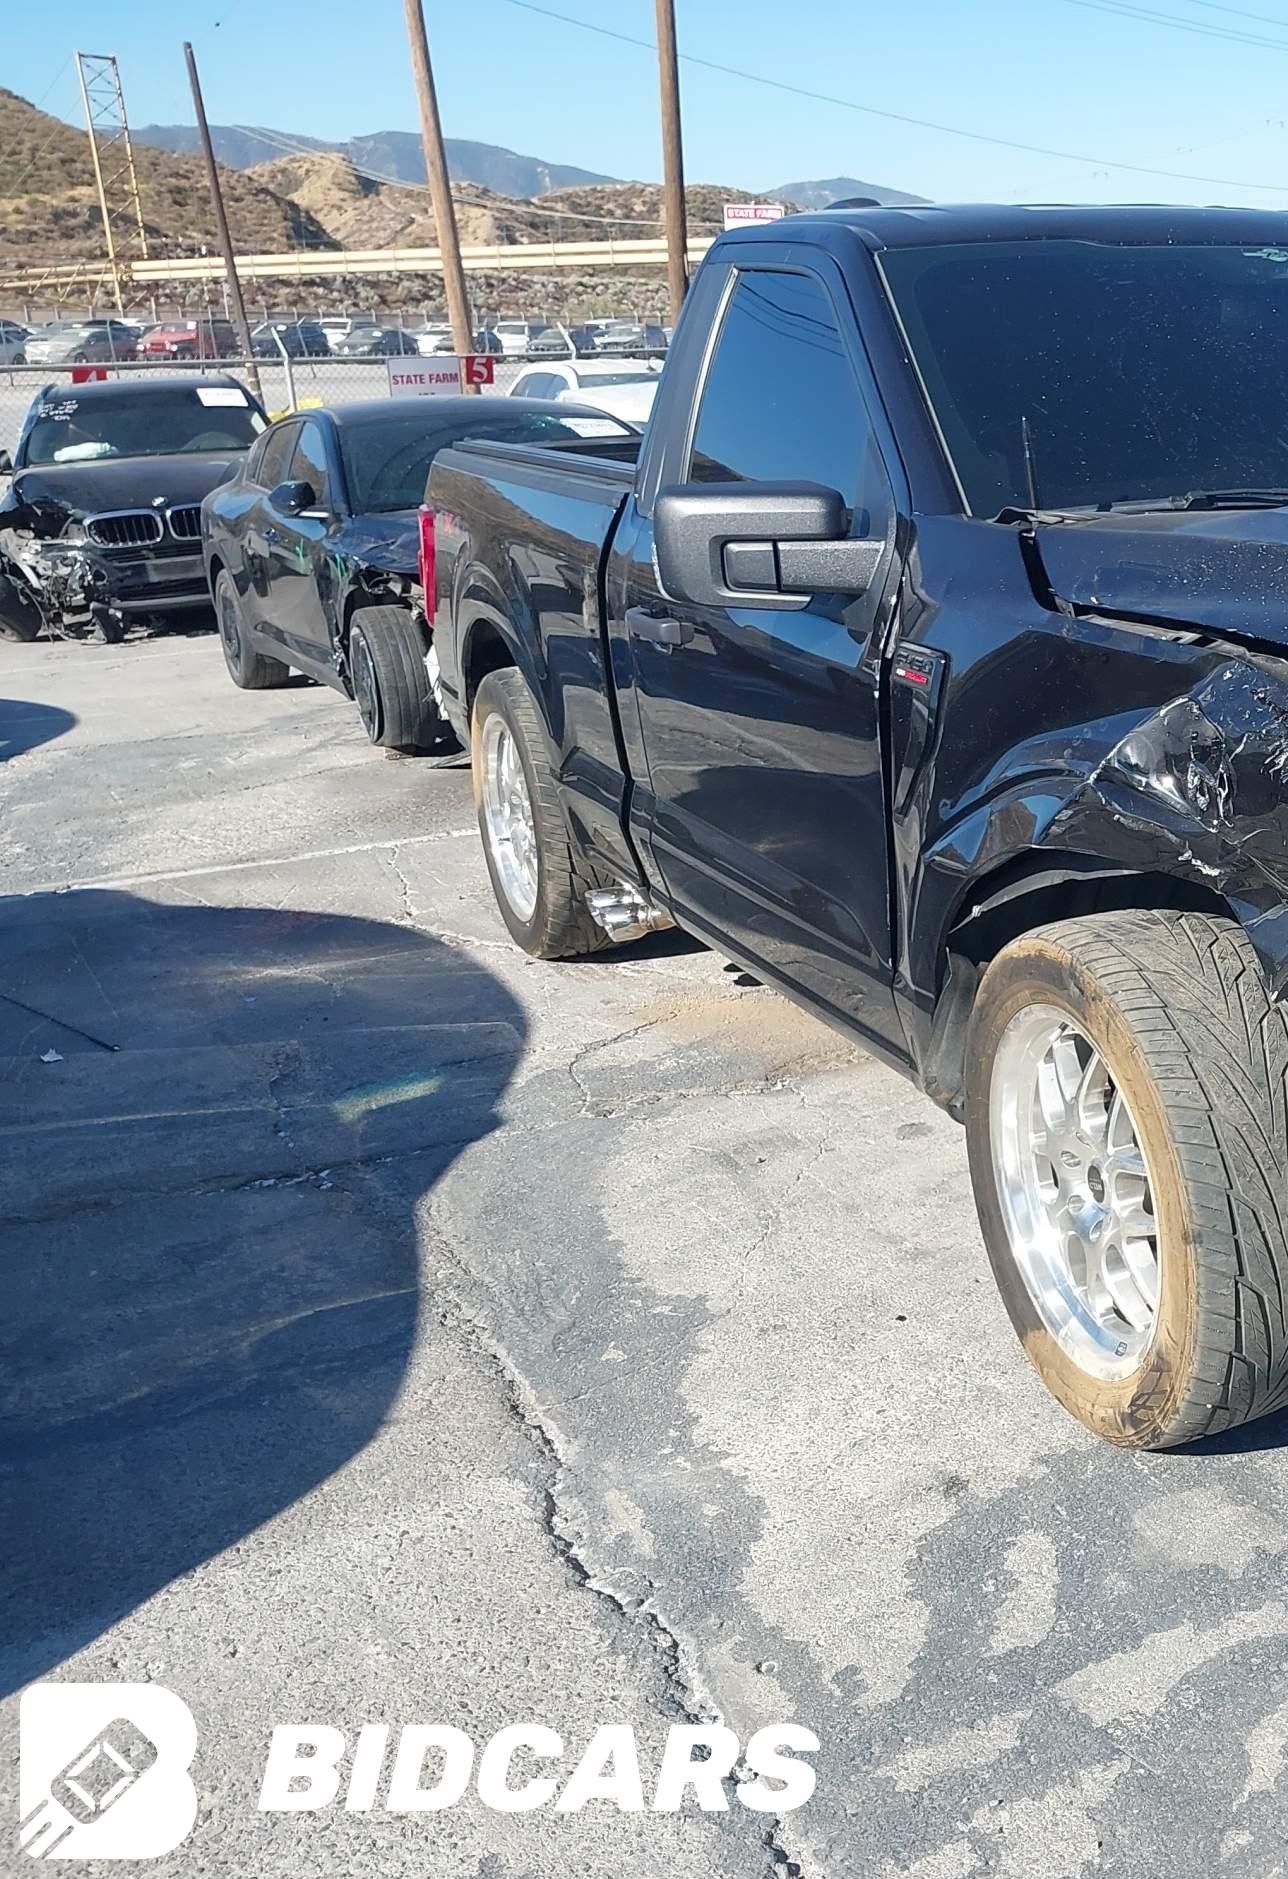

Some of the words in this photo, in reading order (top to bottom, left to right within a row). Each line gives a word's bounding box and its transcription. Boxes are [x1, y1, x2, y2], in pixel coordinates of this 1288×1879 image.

[392, 373, 425, 385] STATE
[428, 373, 459, 383] FARM
[473, 358, 488, 382] 5
